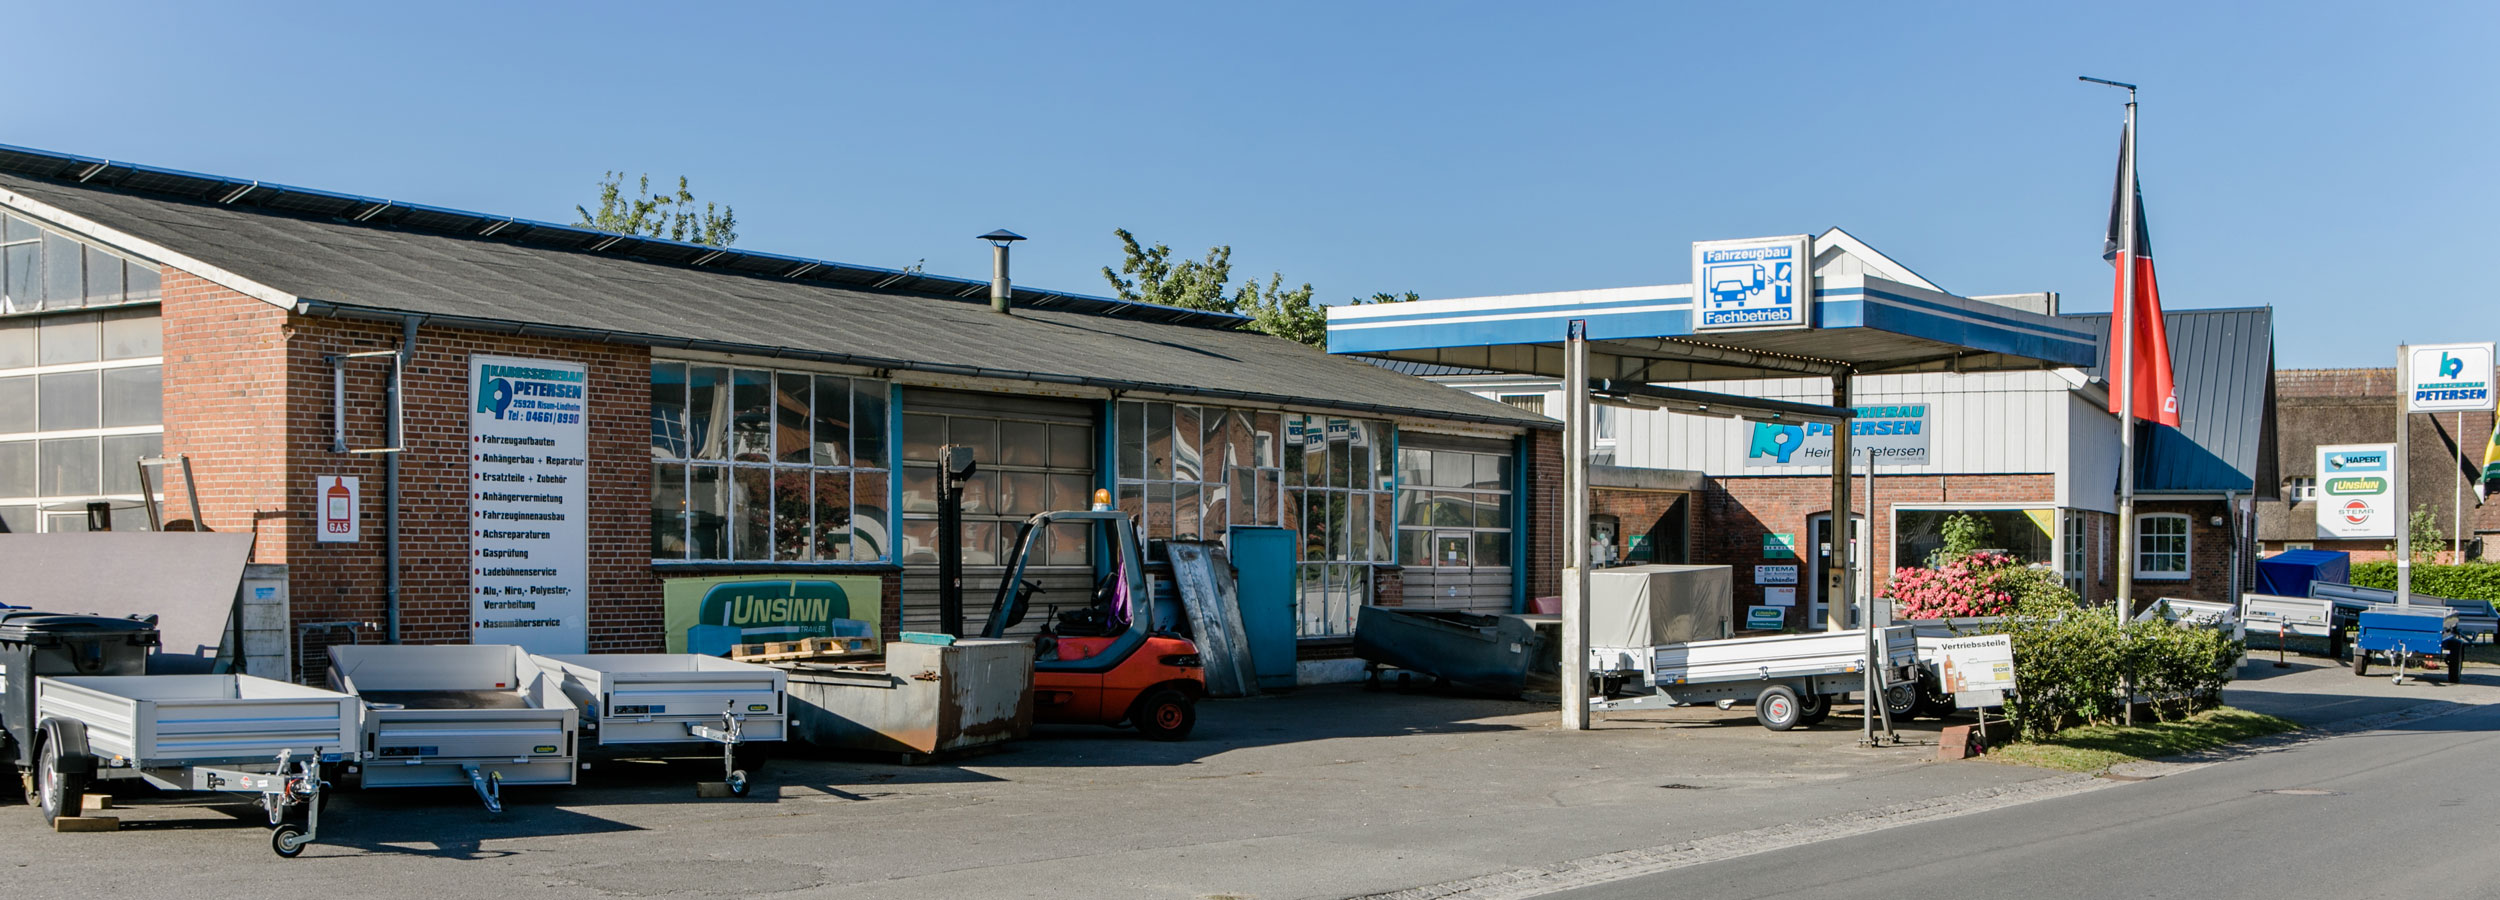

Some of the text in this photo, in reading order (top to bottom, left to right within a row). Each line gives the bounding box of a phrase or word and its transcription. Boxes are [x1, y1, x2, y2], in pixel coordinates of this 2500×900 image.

[1707, 247, 1789, 262] Fahrzeugbau
[1706, 308, 1790, 324] Fachbetrieb
[514, 381, 583, 399] PETERSEN
[2415, 389, 2487, 401] PETERSEN
[513, 399, 536, 409] 25920
[1806, 421, 1922, 437] PEERSEN
[482, 434, 556, 447] Fahrzeugaufbauten
[482, 453, 535, 465] Anhängerbau
[545, 456, 585, 467] Reparatur
[2346, 456, 2381, 464] HAPERT
[482, 472, 525, 482] Ersatzteile
[536, 473, 568, 484] Zubehör
[2338, 478, 2379, 490] UNSINN
[482, 491, 563, 505] Anhängervermietung
[482, 510, 565, 522] Fahrzeuginnenausbau
[329, 521, 349, 533] GAS
[482, 529, 551, 540] Achsreparaturen
[482, 548, 529, 560] Gasprüfung
[482, 567, 558, 577] Ladebühnenservice
[483, 600, 536, 610] Verarbeitung
[733, 579, 830, 625] UNSINN
[801, 625, 827, 634] TRAILER
[1941, 640, 2007, 650] Vertriebsstelle
